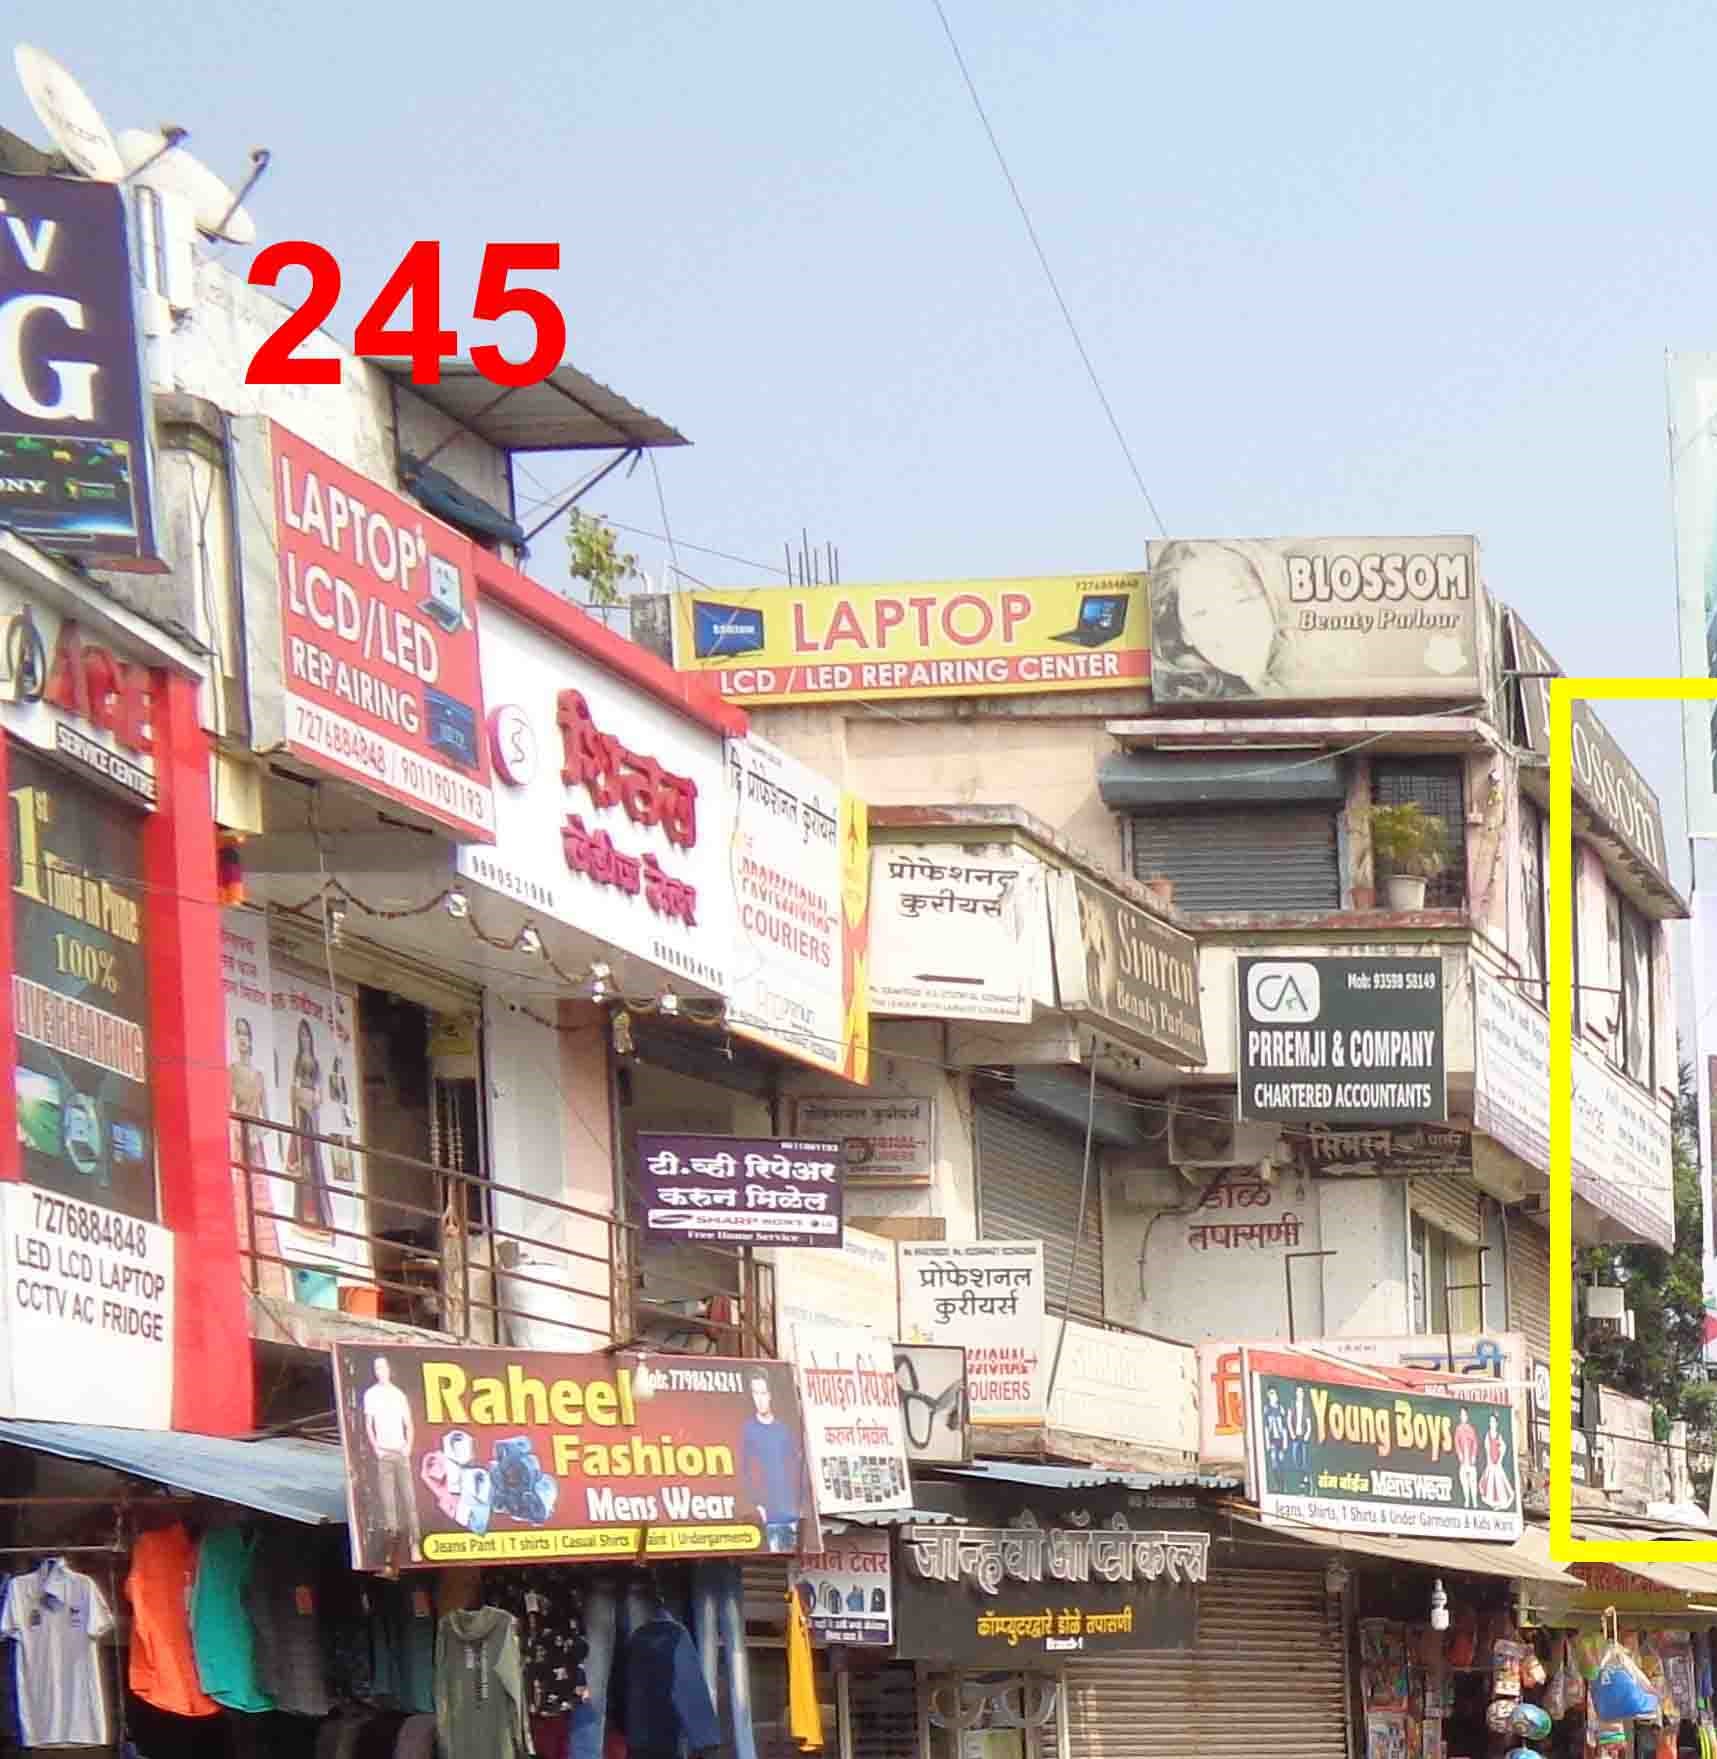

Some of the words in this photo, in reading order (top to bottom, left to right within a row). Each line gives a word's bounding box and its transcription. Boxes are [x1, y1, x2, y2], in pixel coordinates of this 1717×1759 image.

[281, 456, 419, 590] LAPTOP
[1286, 553, 1472, 603] BLOSSOM
[287, 553, 439, 684] LCD/LED
[793, 594, 1032, 654] LAPTOP
[1299, 608, 1375, 634] Beauty
[1378, 607, 1461, 631] Parlour
[291, 636, 420, 733] REPAIRING
[720, 669, 777, 696] LCD
[806, 664, 853, 691] LED
[863, 656, 1009, 688] REPAIRING
[1019, 653, 1119, 681] CENTER
[54, 932, 119, 994] 100%
[741, 903, 832, 969] COURIERS
[1117, 907, 1196, 1009] Simran
[1248, 1030, 1327, 1068] PRREMJI
[1331, 1030, 1345, 1068] &
[1350, 1030, 1435, 1068] COMPANY
[1254, 1083, 1333, 1109] CHARTERED
[1335, 1083, 1432, 1109] ACCOUNTANTS
[33, 1192, 148, 1259] 7276884848
[15, 1237, 53, 1275] LED
[59, 1248, 95, 1284] LCD
[99, 1261, 166, 1301] LAPTOP
[917, 1259, 1033, 1288] प्रोफेशनल
[16, 1277, 69, 1321] CCTV
[71, 1290, 96, 1327] AC
[101, 1299, 165, 1342] FRIDGE
[933, 1288, 1020, 1325] कुरीयर्स
[421, 1361, 637, 1427] Raheel
[968, 1381, 1031, 1401] OURIERS
[1311, 1387, 1391, 1458] Young
[1394, 1398, 1452, 1463] Boys
[552, 1434, 735, 1478] Fashion
[586, 1486, 658, 1522] Mens
[660, 1486, 737, 1521] Wear
[1350, 1506, 1377, 1523] Shirts
[432, 1539, 468, 1554] Jeans
[469, 1538, 496, 1553] Pant
[561, 1535, 597, 1550] Casual
